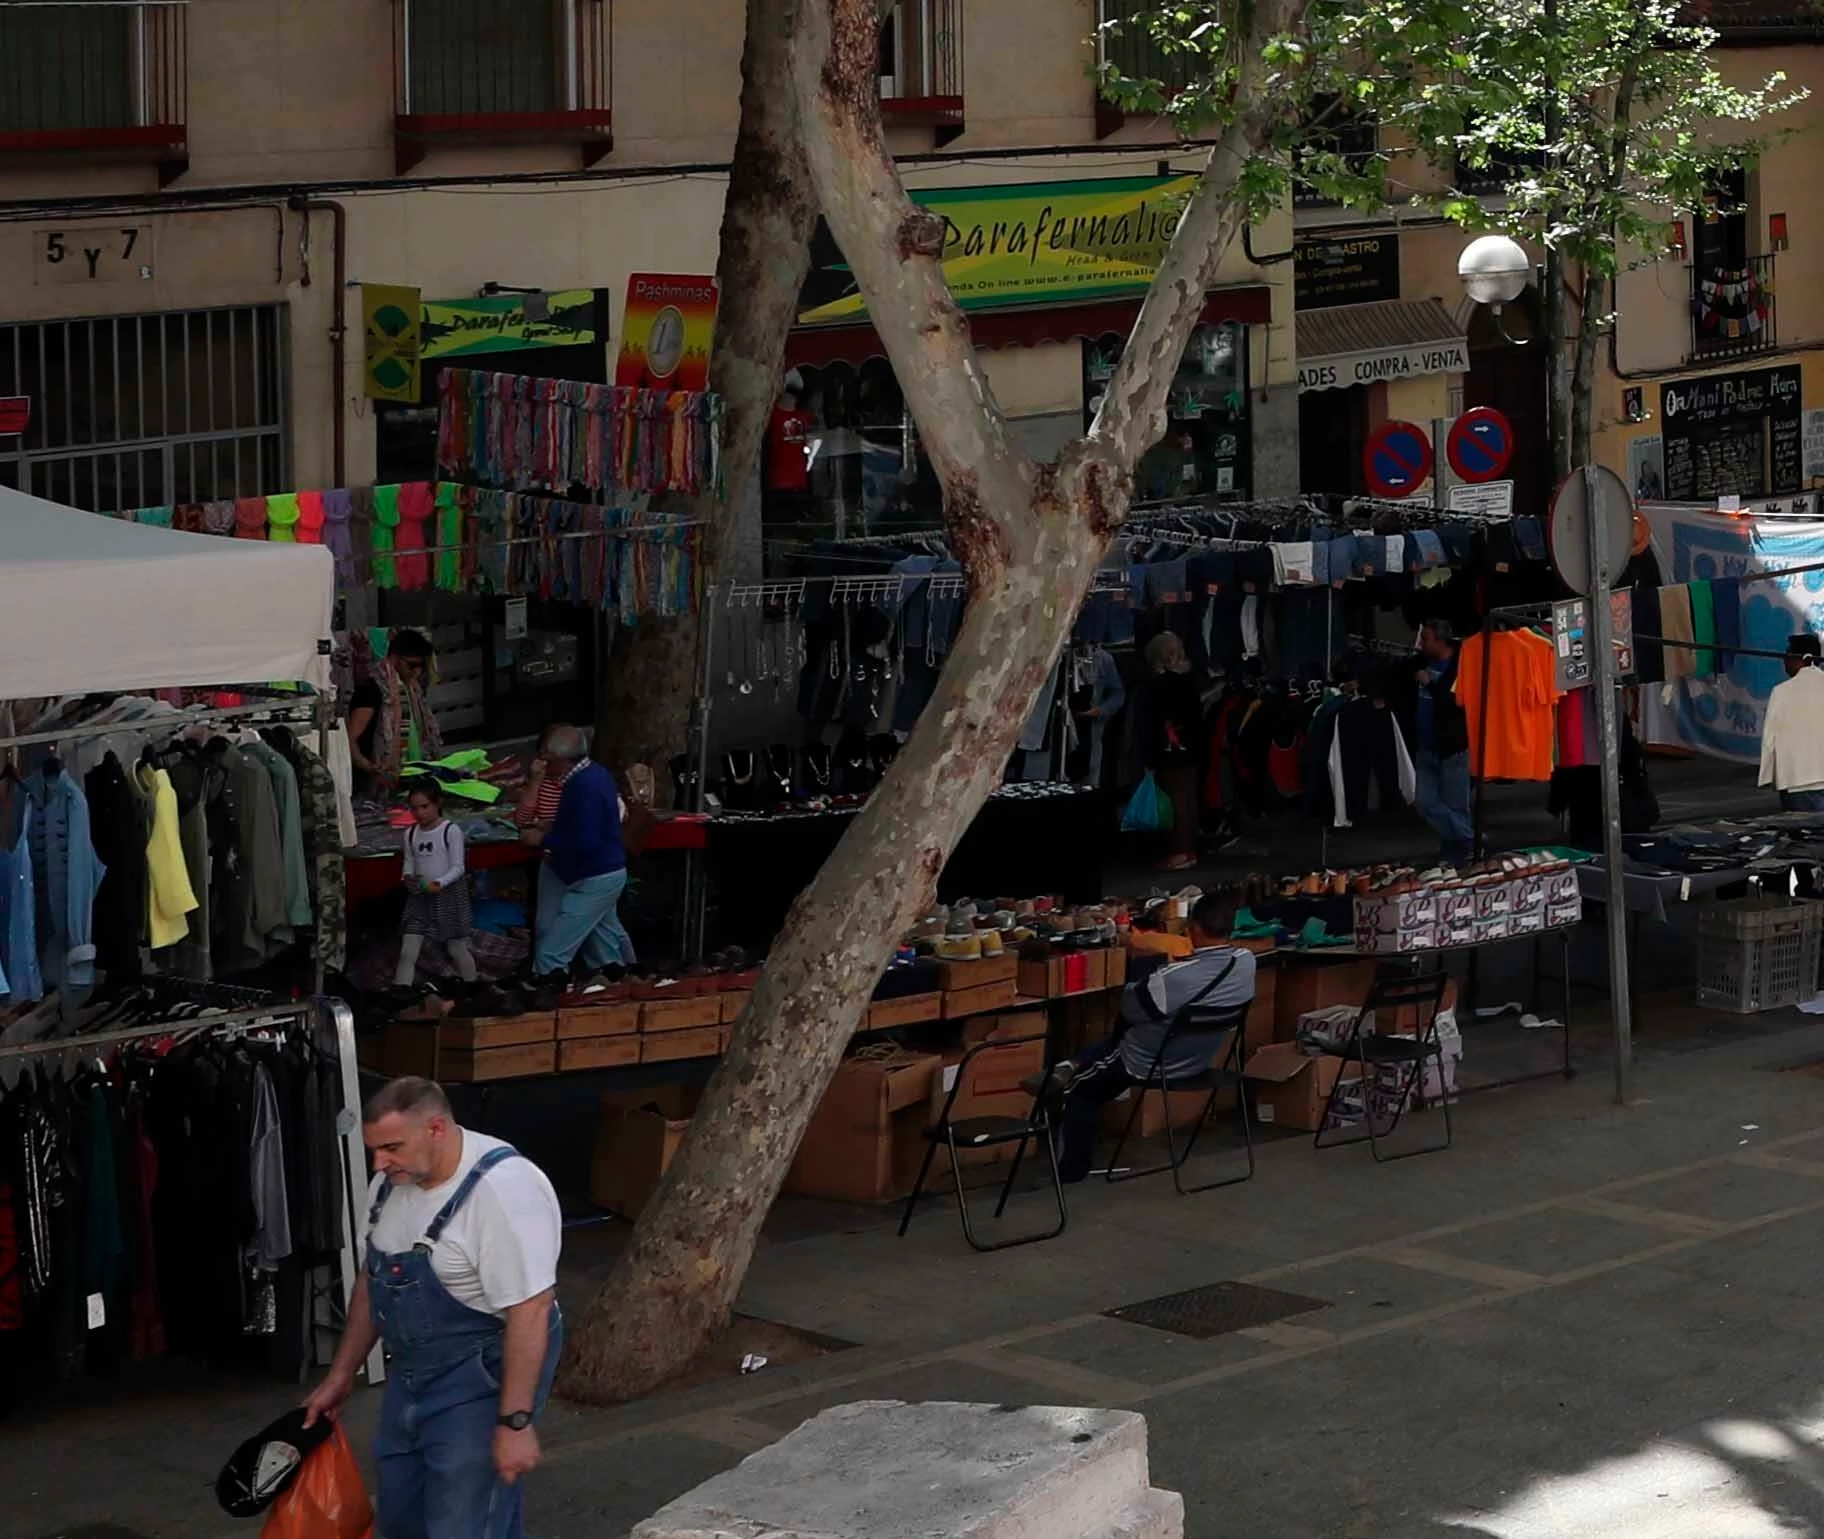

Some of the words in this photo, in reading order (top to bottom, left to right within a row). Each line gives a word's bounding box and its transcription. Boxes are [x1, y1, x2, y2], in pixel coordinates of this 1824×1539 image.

[47, 233, 65, 263] 5
[84, 248, 100, 279] Y
[121, 229, 138, 259] 7
[634, 278, 714, 304] Pashminas
[1354, 356, 1411, 381] COMPRA
[1421, 349, 1465, 371] VENTA
